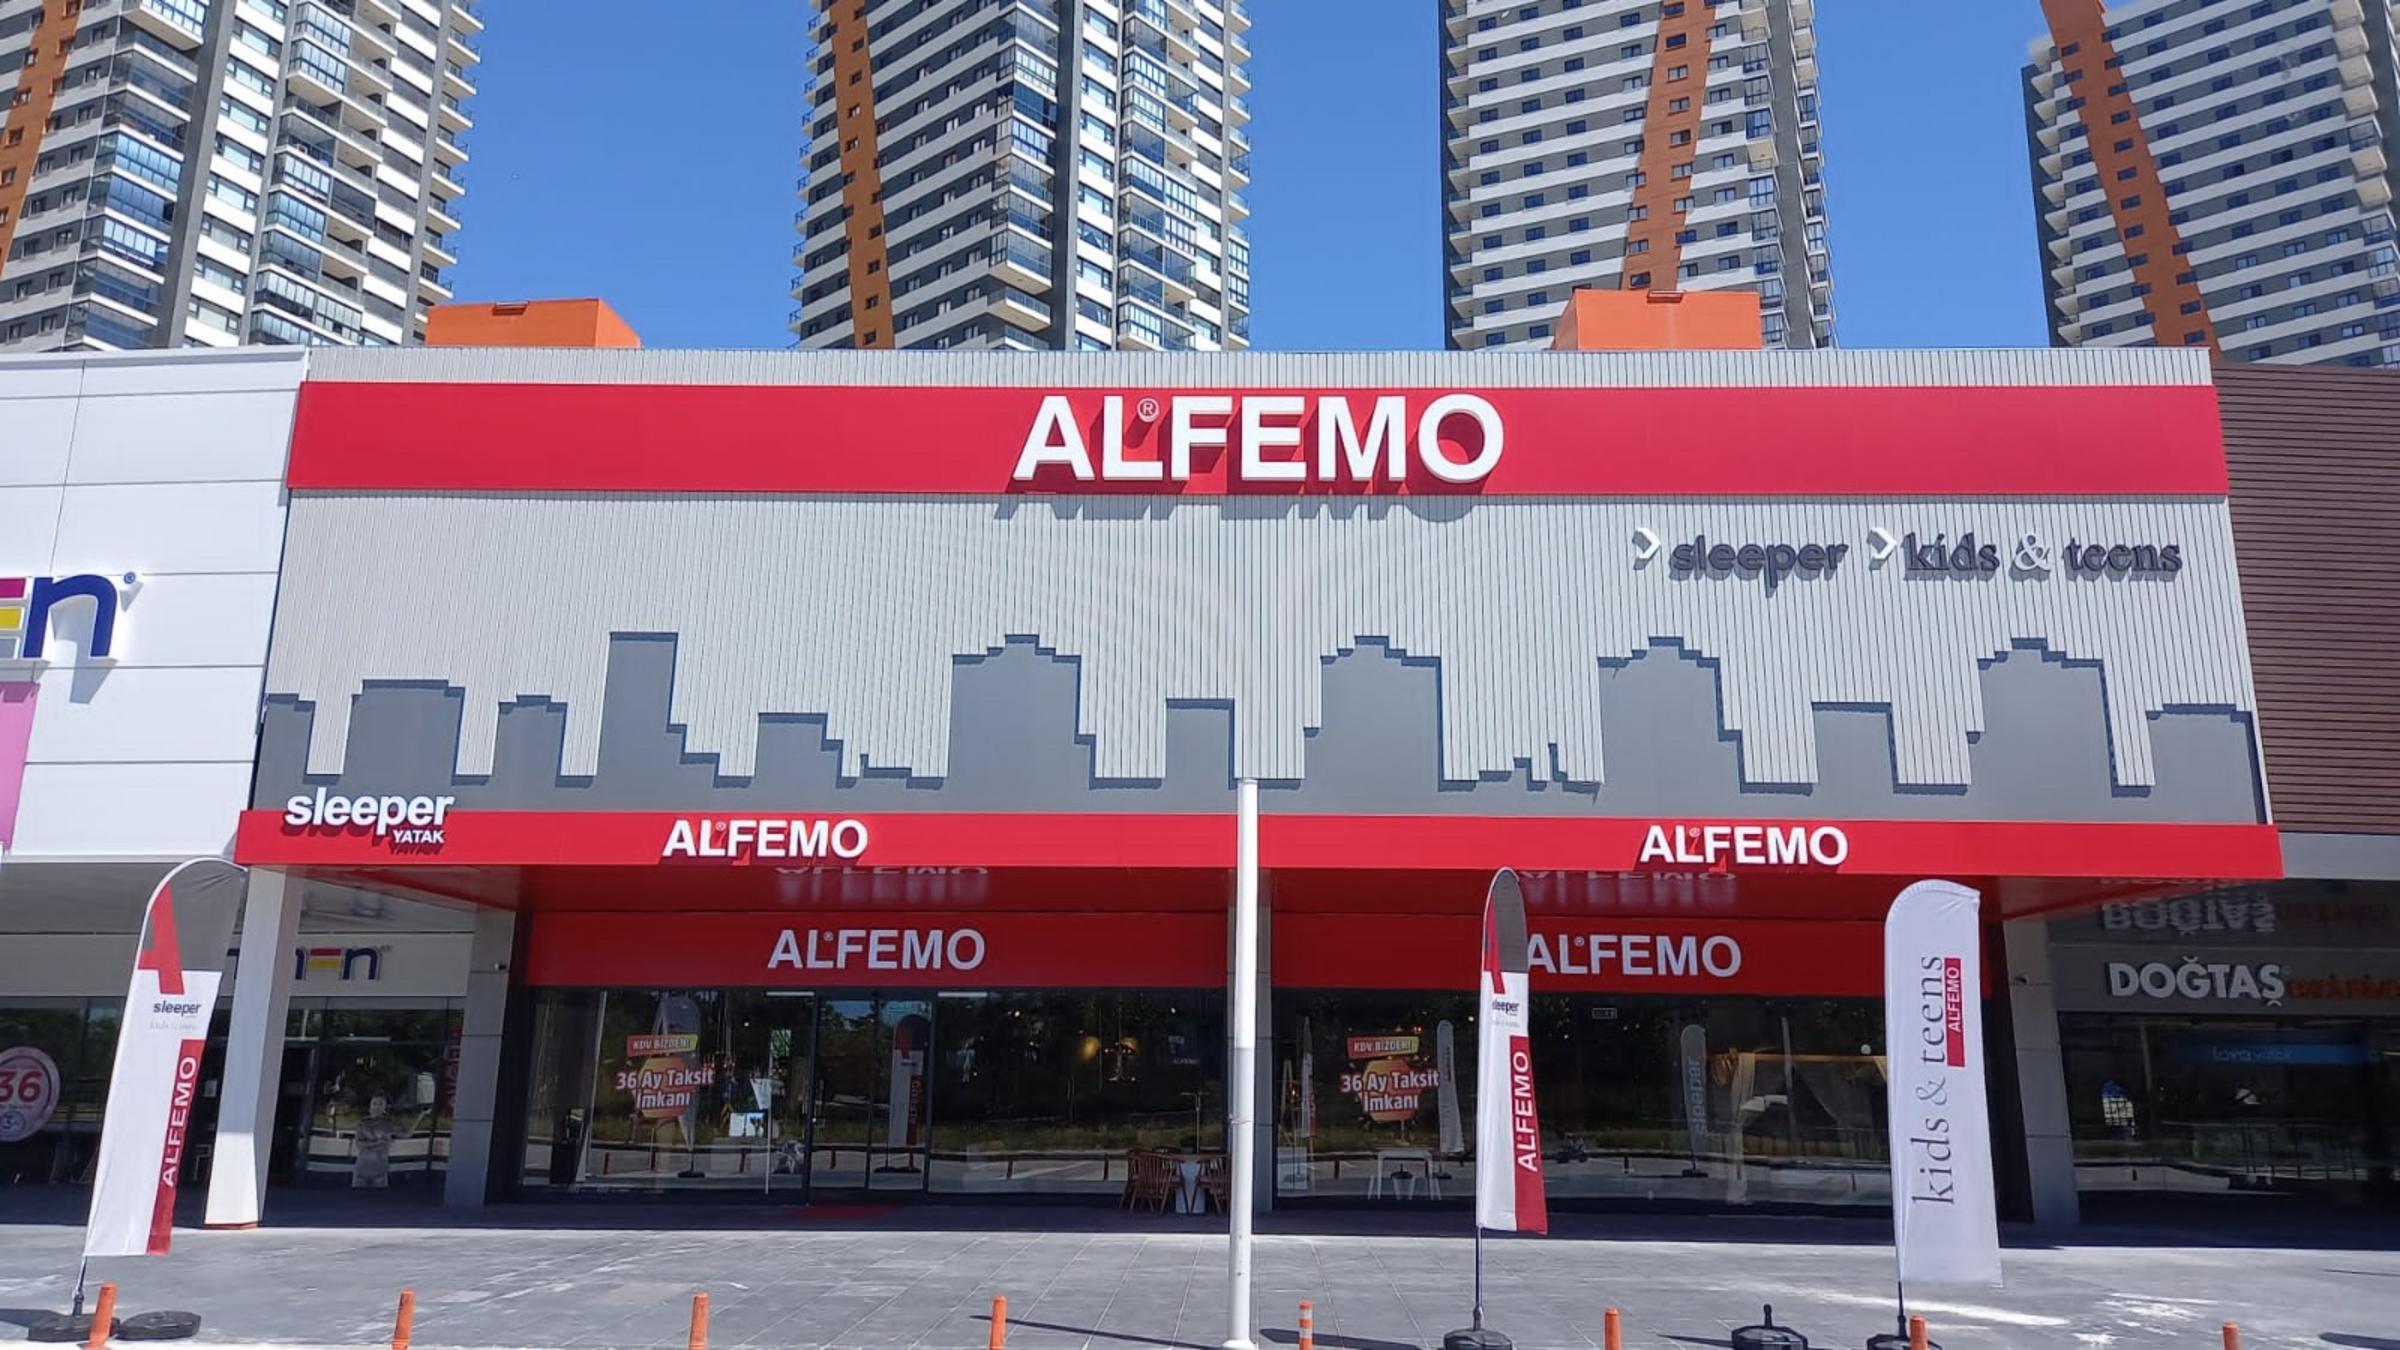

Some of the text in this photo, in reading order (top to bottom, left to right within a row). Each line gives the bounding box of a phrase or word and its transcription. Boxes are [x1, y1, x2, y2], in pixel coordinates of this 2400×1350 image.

[1671, 535, 1849, 590] sleeper
[1902, 531, 2183, 571] kids & teens
[285, 787, 455, 835] sleeper
[393, 830, 445, 844] YATAK
[1946, 966, 1962, 1032] ALFEMO
[2109, 955, 2285, 1007] DOĞTAŞ
[153, 1000, 201, 1017] sleeper
[0, 1070, 42, 1103] 36
[616, 1067, 715, 1090] 36 Ay Taksit
[1341, 1069, 1439, 1092] 36 Ay Taksit
[1911, 957, 1954, 1204] kids & teens
[162, 1056, 196, 1187] ALFEMO
[1512, 1051, 1538, 1172] ALFEMO
